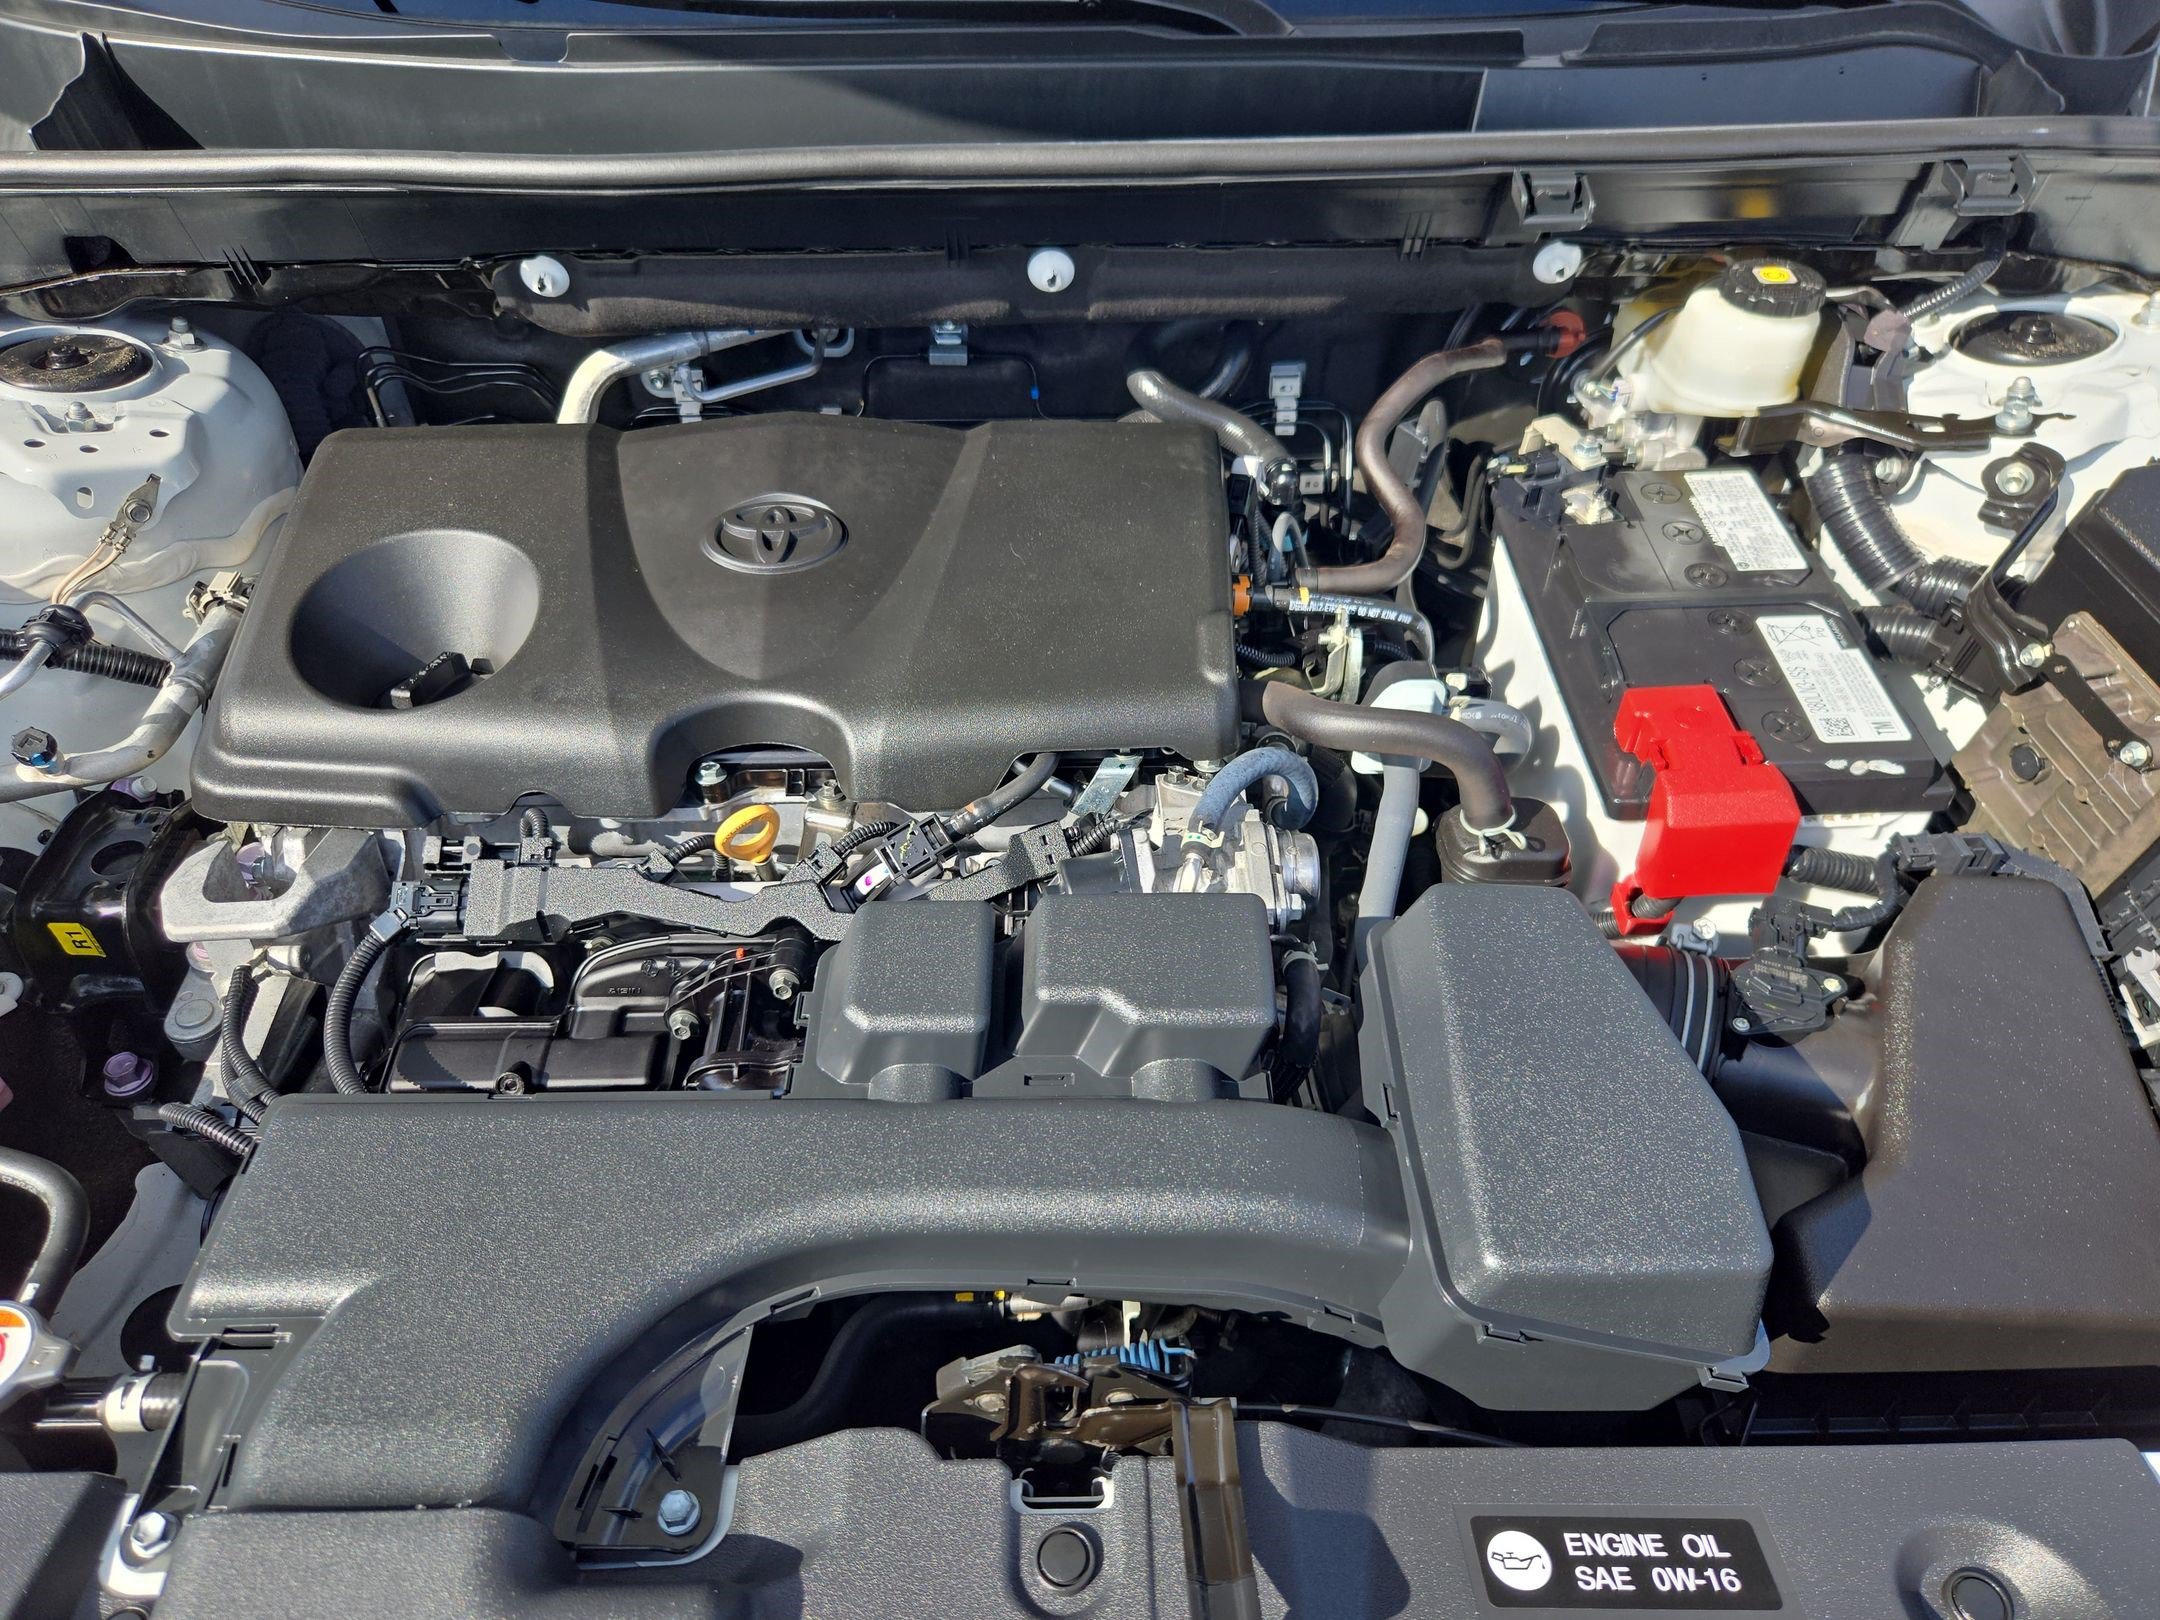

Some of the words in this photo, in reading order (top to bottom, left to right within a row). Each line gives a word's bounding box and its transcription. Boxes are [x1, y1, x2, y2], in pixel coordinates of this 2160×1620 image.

[64, 930, 93, 949] R1
[1563, 1532, 1668, 1557] ENGINE
[1681, 1533, 1732, 1558] OIL
[1574, 1566, 1637, 1591] SAE
[1651, 1567, 1743, 1592] 0W-16
